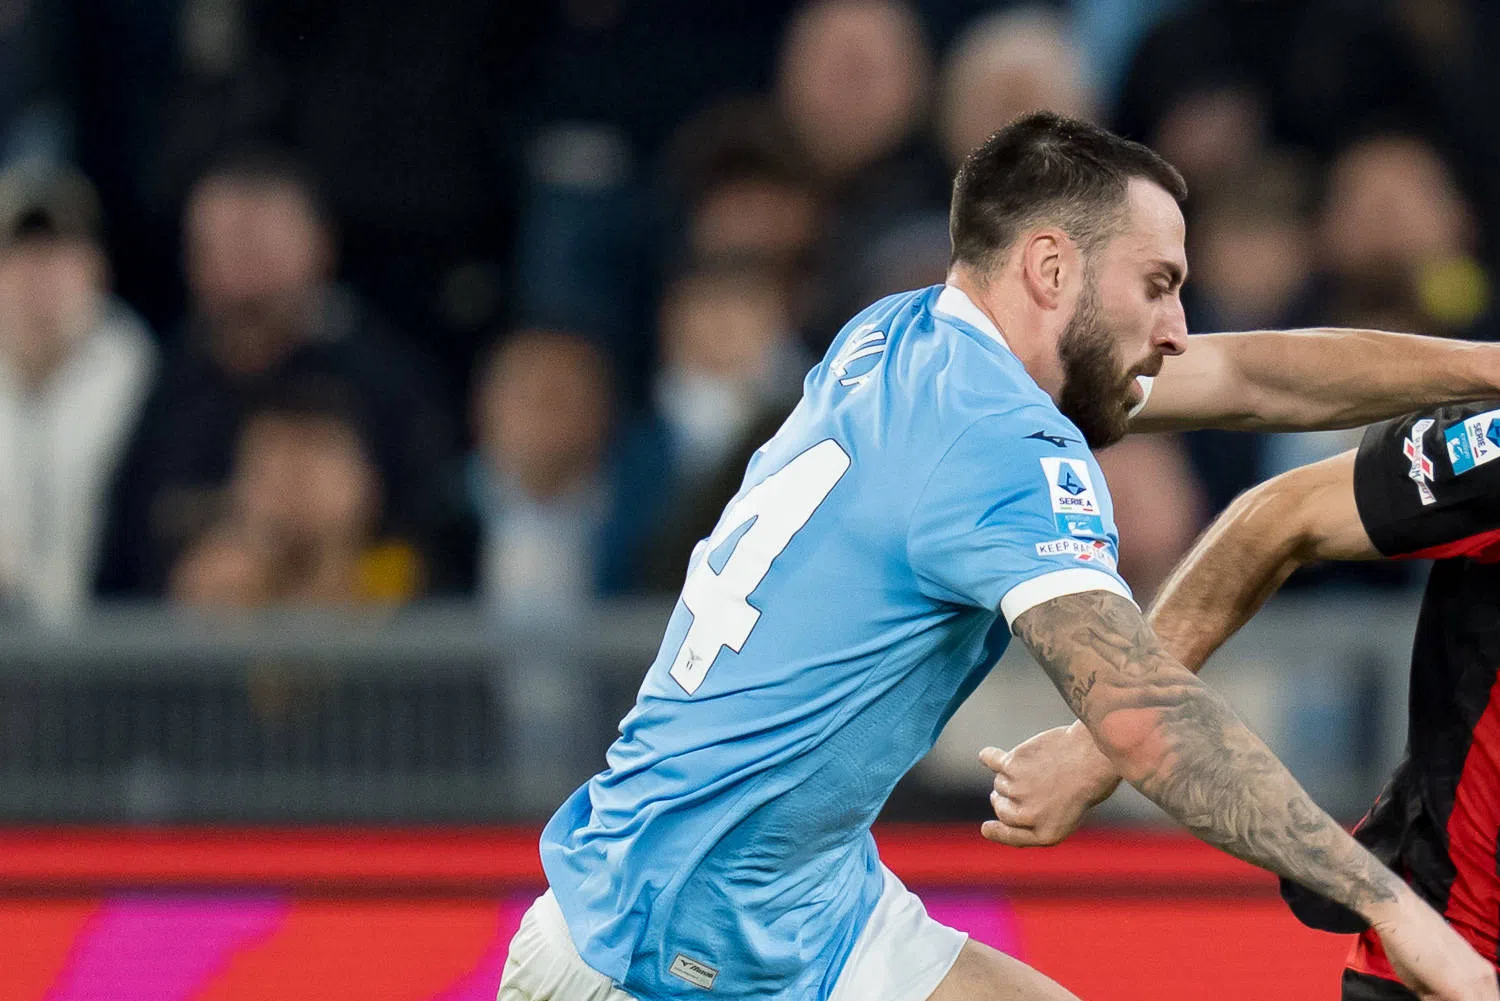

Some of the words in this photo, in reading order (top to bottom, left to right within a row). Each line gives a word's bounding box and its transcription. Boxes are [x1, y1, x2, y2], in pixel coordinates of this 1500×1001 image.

[1473, 422, 1485, 448] SERIE
[1059, 497, 1084, 507] SERIE
[1039, 541, 1070, 553] KEEP
